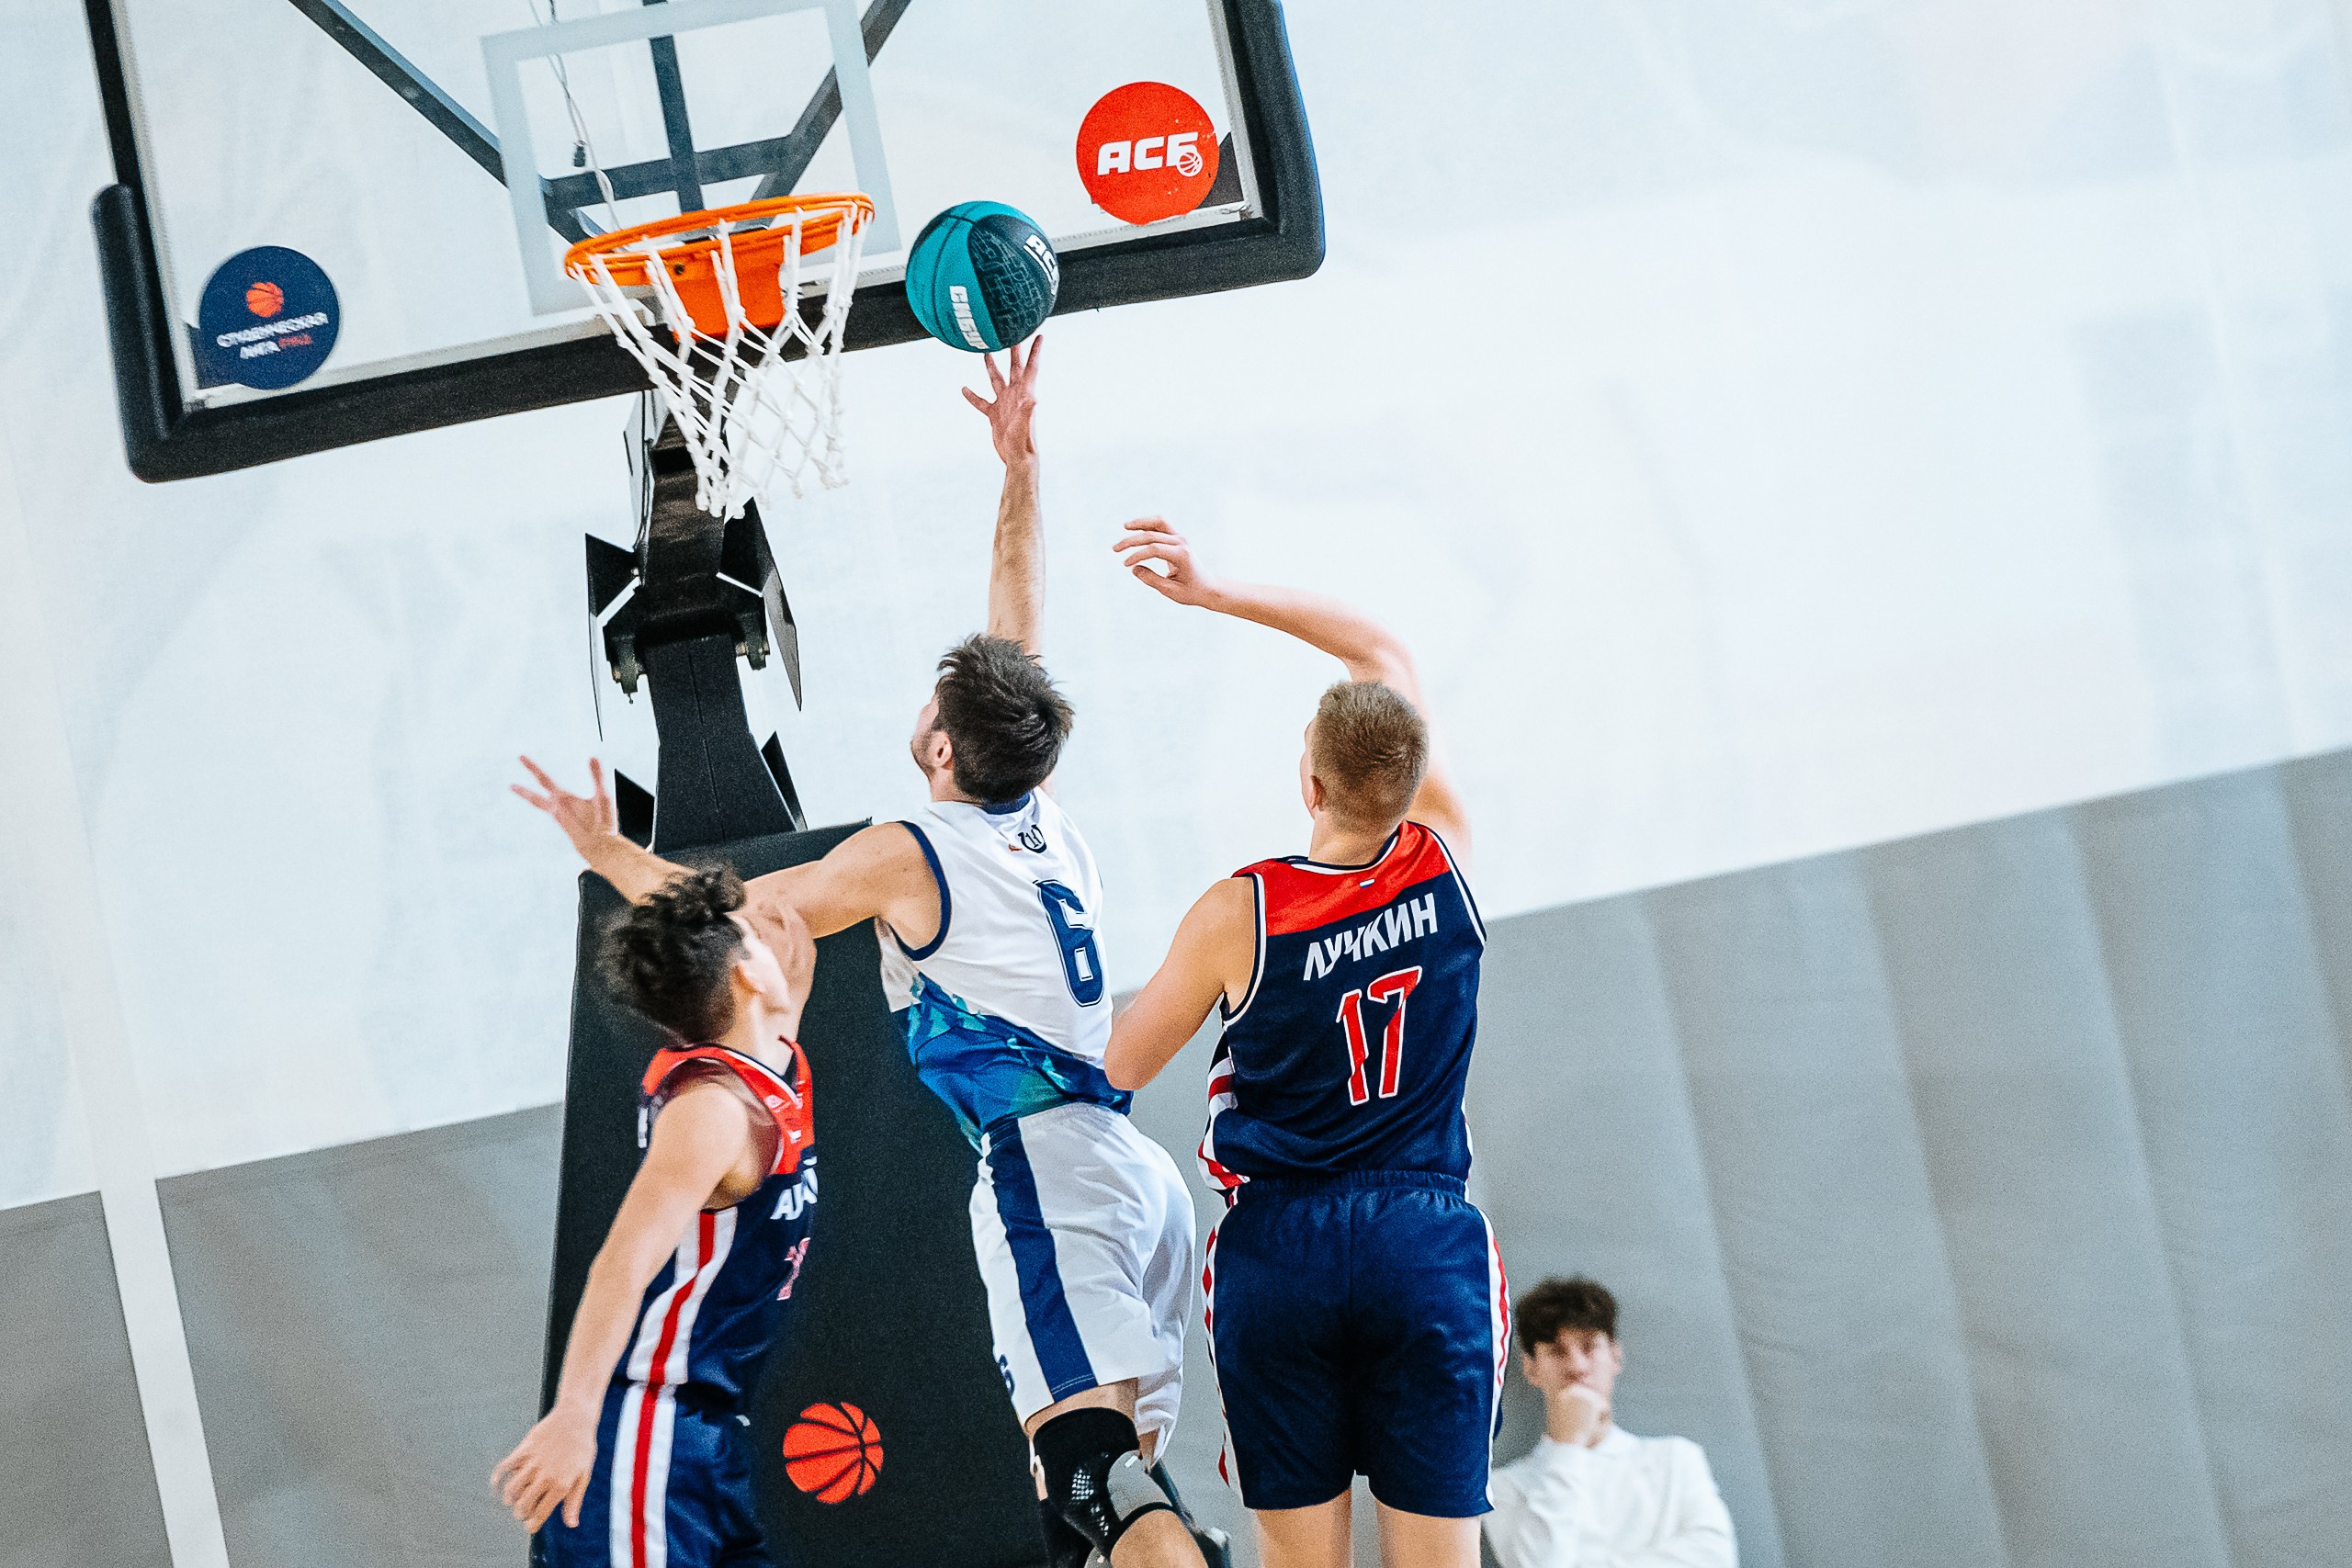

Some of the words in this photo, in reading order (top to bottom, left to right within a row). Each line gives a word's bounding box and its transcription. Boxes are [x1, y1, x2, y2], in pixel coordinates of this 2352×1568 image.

[1097, 131, 1203, 176] АСБ
[1036, 879, 1104, 1008] 6
[1303, 892, 1438, 981] ЛУЧКИН
[1335, 964, 1423, 1106] 17
